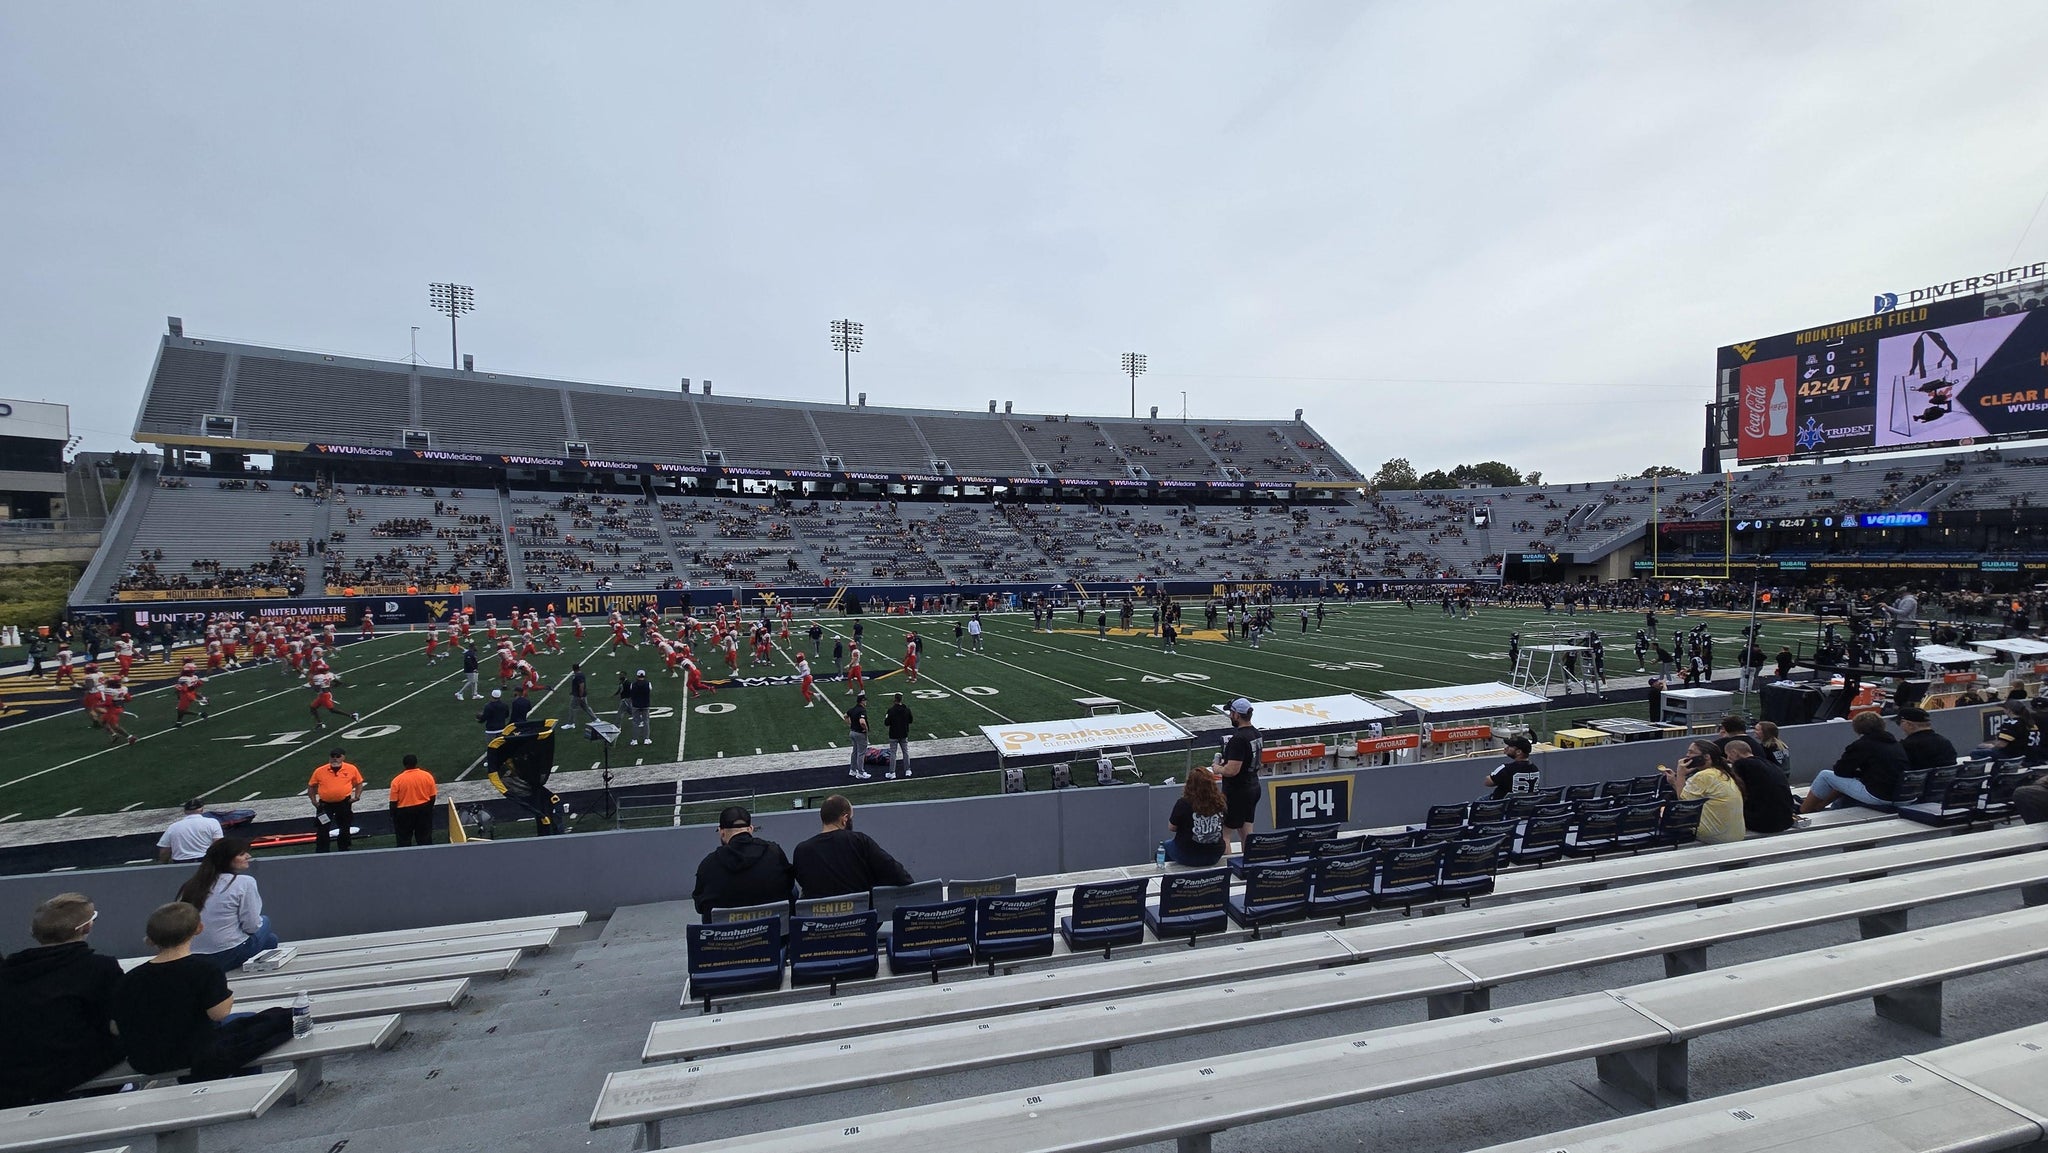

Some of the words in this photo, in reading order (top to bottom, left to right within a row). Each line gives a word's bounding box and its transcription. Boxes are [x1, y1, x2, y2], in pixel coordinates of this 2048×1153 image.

[1796, 315, 1883, 345] MOUNTAINEER
[1888, 307, 1928, 327] FIELD
[1826, 351, 1836, 362] 0
[1826, 364, 1836, 375] 0
[1798, 375, 1852, 397] 42:47
[1980, 390, 2038, 407] CLEAR
[1824, 425, 1874, 436] TRIDENT
[1755, 520, 1763, 529] 0
[1778, 518, 1806, 528] 42:47
[1824, 517, 1833, 527] 0
[1867, 513, 1923, 525] venmo
[166, 588, 220, 599] MOUNTAINEER
[567, 596, 601, 614] WEST
[260, 607, 297, 617] UNITED
[299, 607, 326, 615] WITH
[327, 606, 347, 614] THE
[911, 686, 1000, 701] 30
[244, 725, 402, 748] 10
[1037, 722, 1169, 743] Panhandle
[1447, 729, 1479, 740] GATORADE
[1375, 739, 1408, 750] GATORADE
[1276, 747, 1313, 760] GATORADE
[1290, 789, 1335, 820] 124
[1184, 875, 1225, 887] Panhandle
[812, 901, 854, 914] RENTED
[917, 906, 967, 918] Panhandle
[729, 910, 772, 923] RENTED
[815, 917, 868, 930] Panhandle
[713, 924, 769, 938] Panhandle
[687, 1066, 700, 1074] 101
[1026, 1095, 1043, 1105] 103
[843, 1126, 861, 1137] 102
